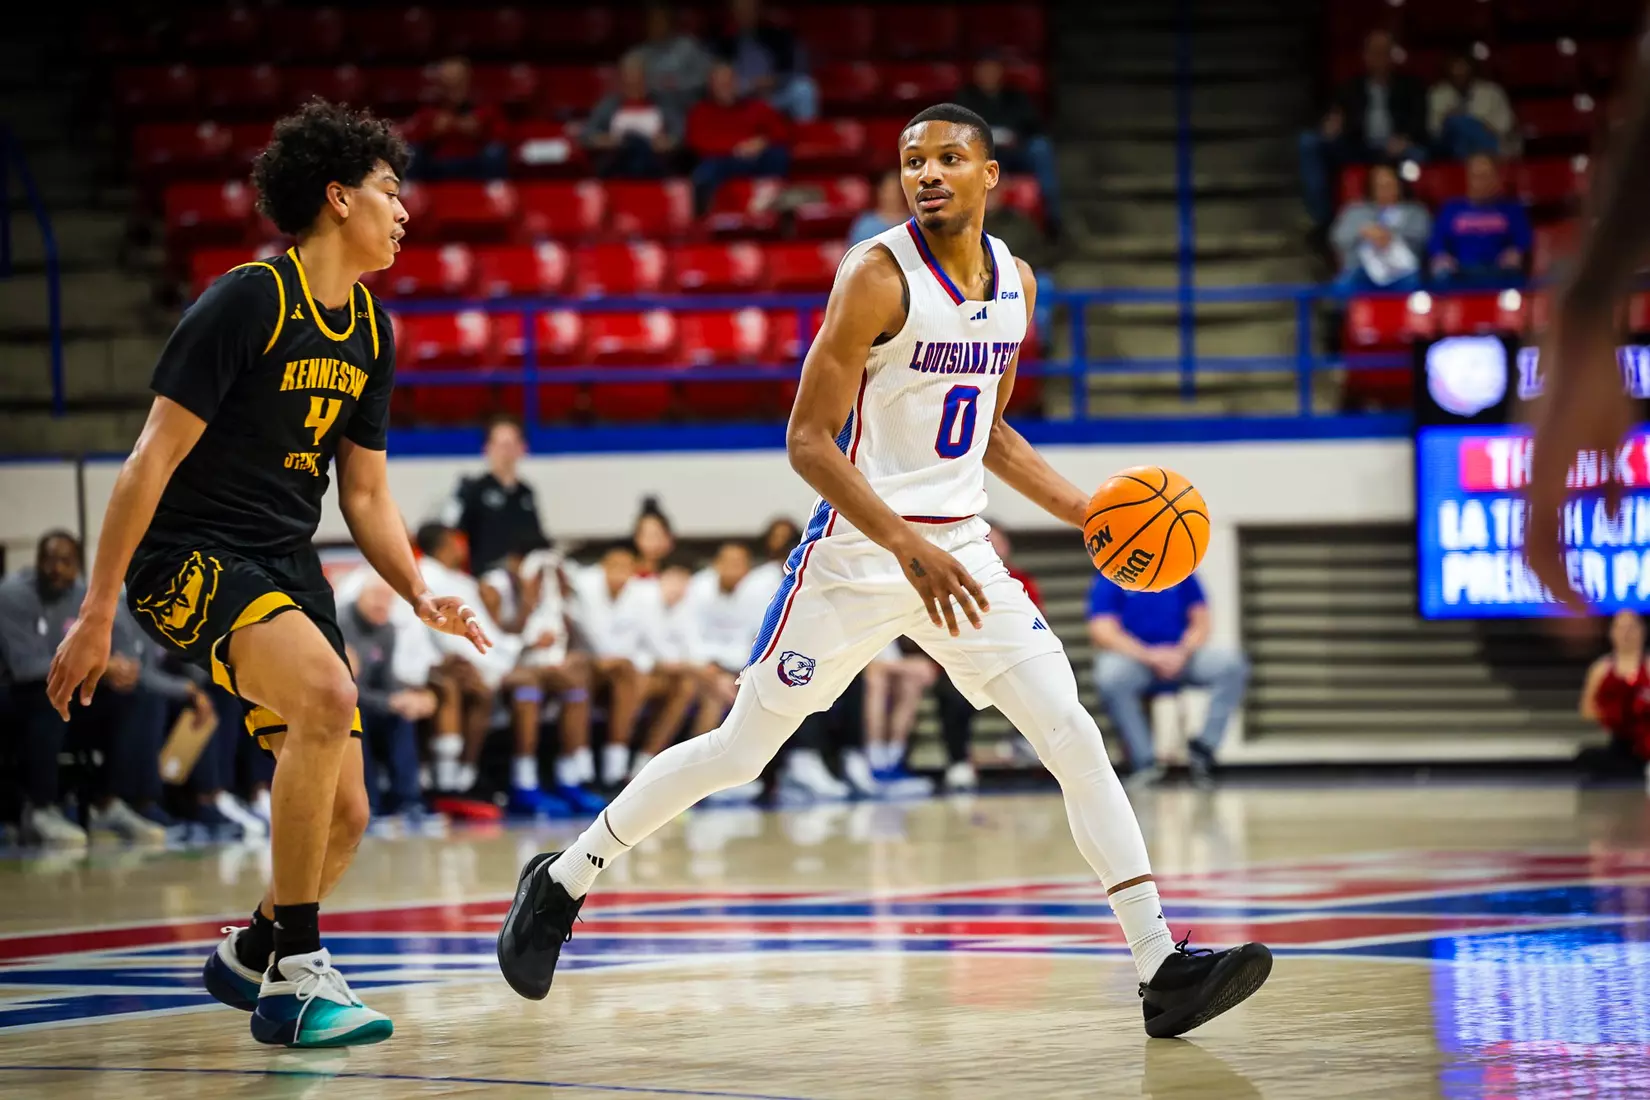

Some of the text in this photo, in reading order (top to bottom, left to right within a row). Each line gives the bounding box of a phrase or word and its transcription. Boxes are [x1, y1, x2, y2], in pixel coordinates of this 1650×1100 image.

[279, 358, 369, 401] KENNESAW
[909, 340, 1019, 375] LOUISIANA TEC
[304, 395, 343, 446] 4
[934, 384, 981, 459] 0
[1486, 434, 1634, 489] THNK
